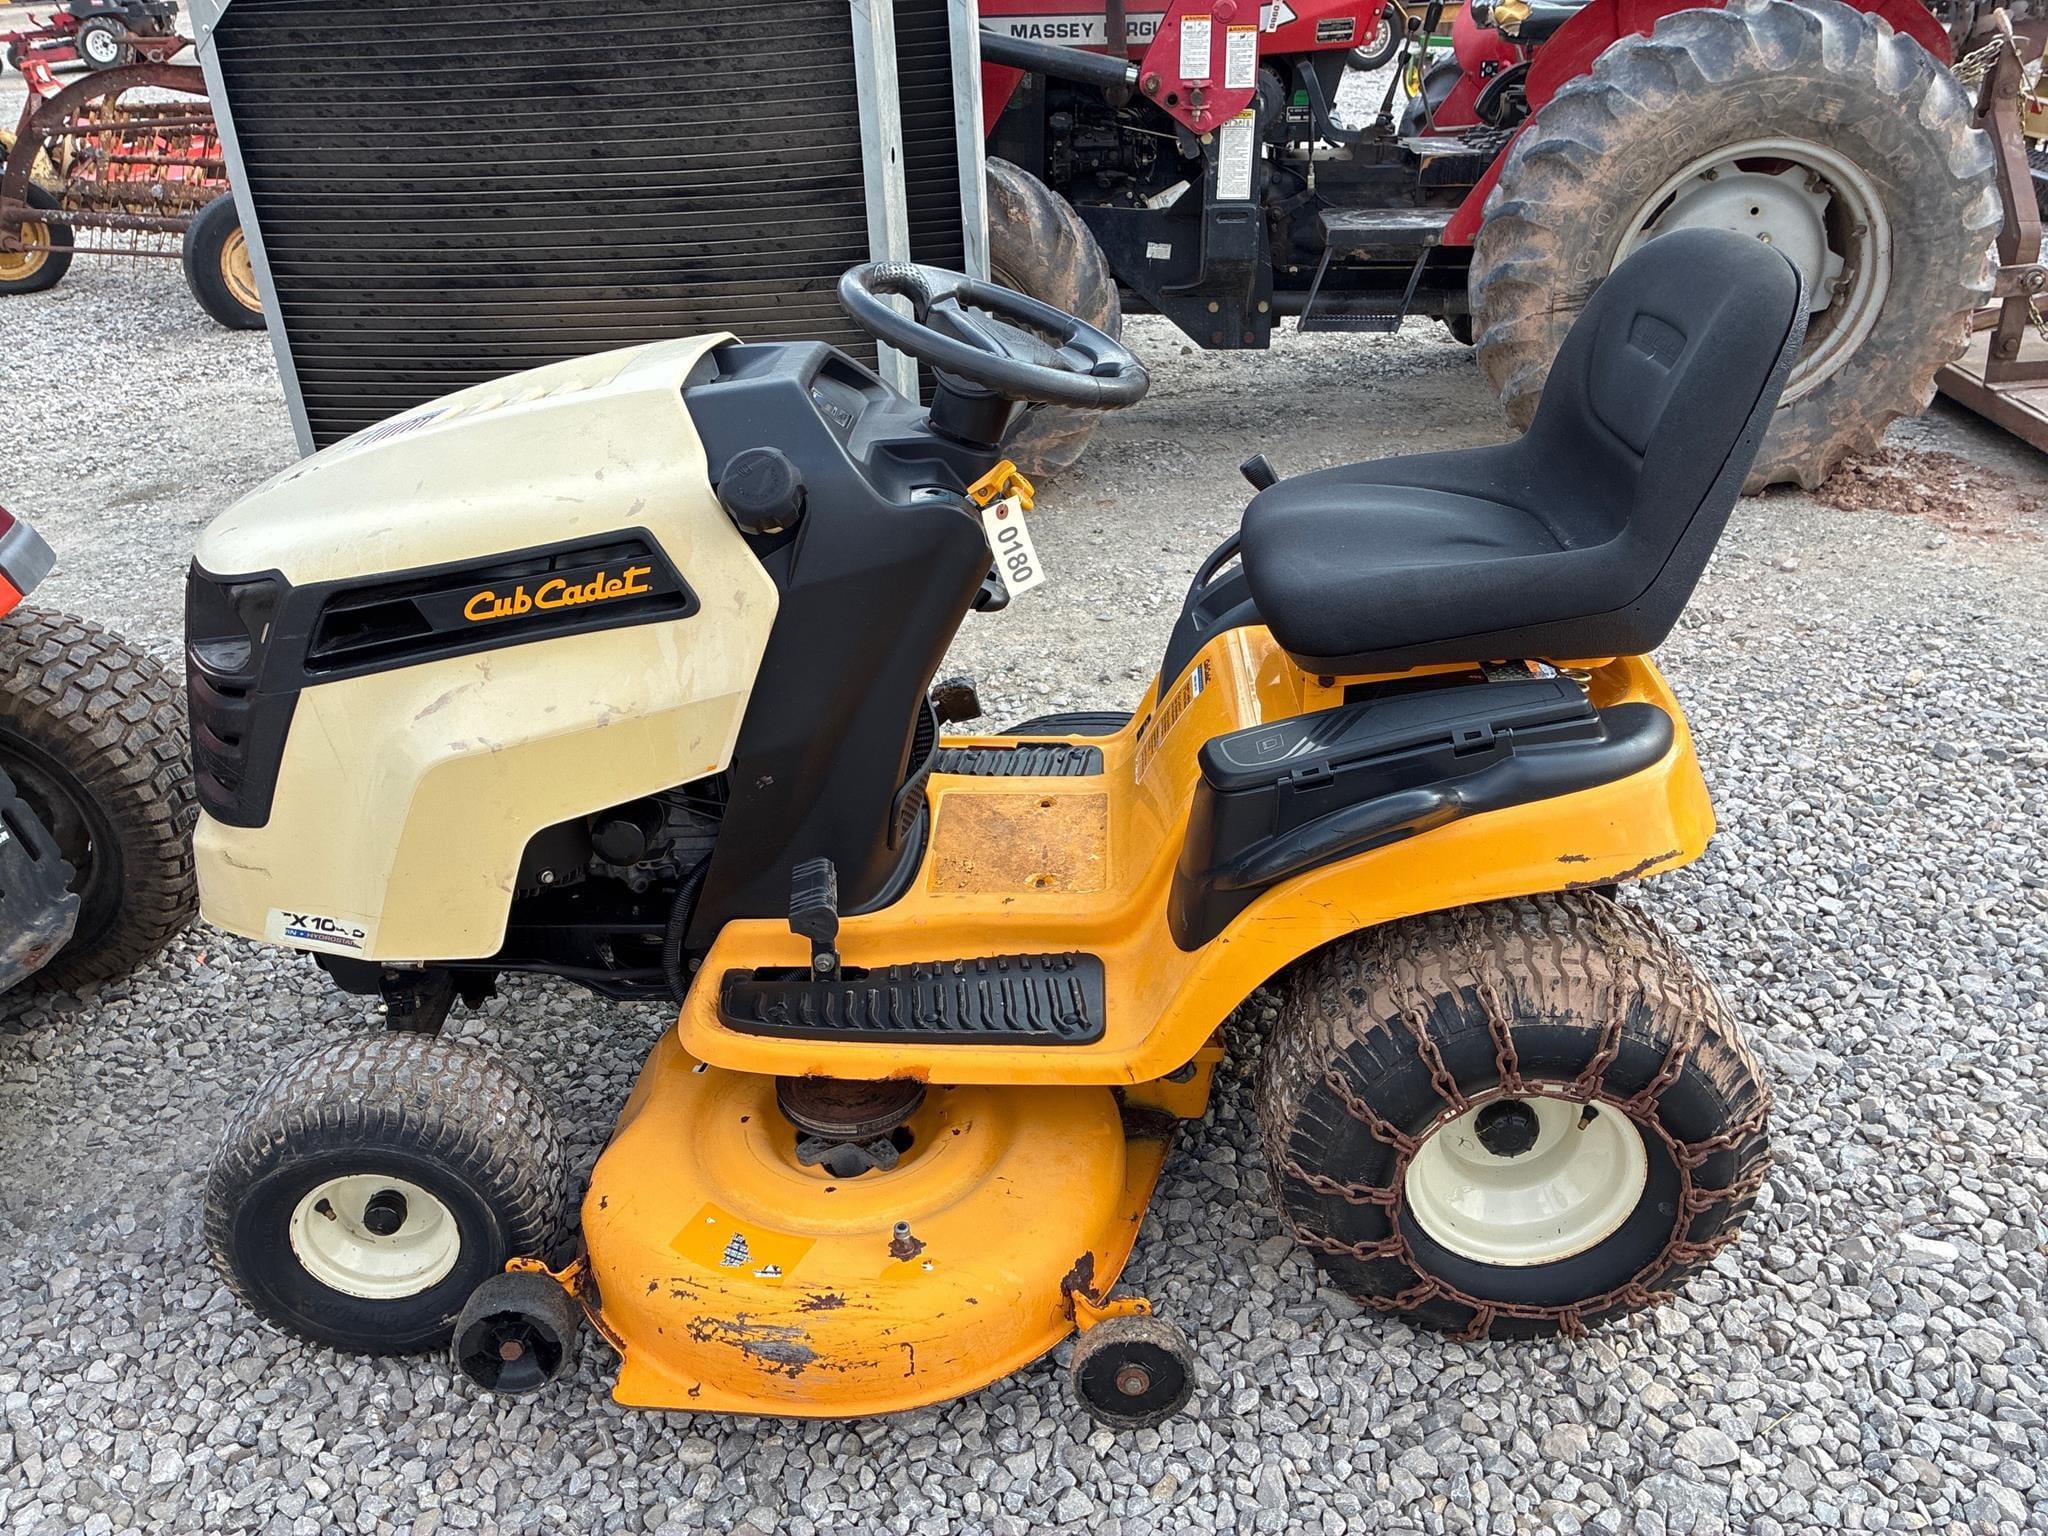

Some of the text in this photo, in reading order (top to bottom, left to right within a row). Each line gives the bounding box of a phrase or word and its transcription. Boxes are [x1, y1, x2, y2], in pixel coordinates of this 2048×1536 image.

[1010, 22, 1094, 39] MASSEY
[997, 526, 1033, 583] 0180
[463, 566, 651, 621] Cub Cadet
